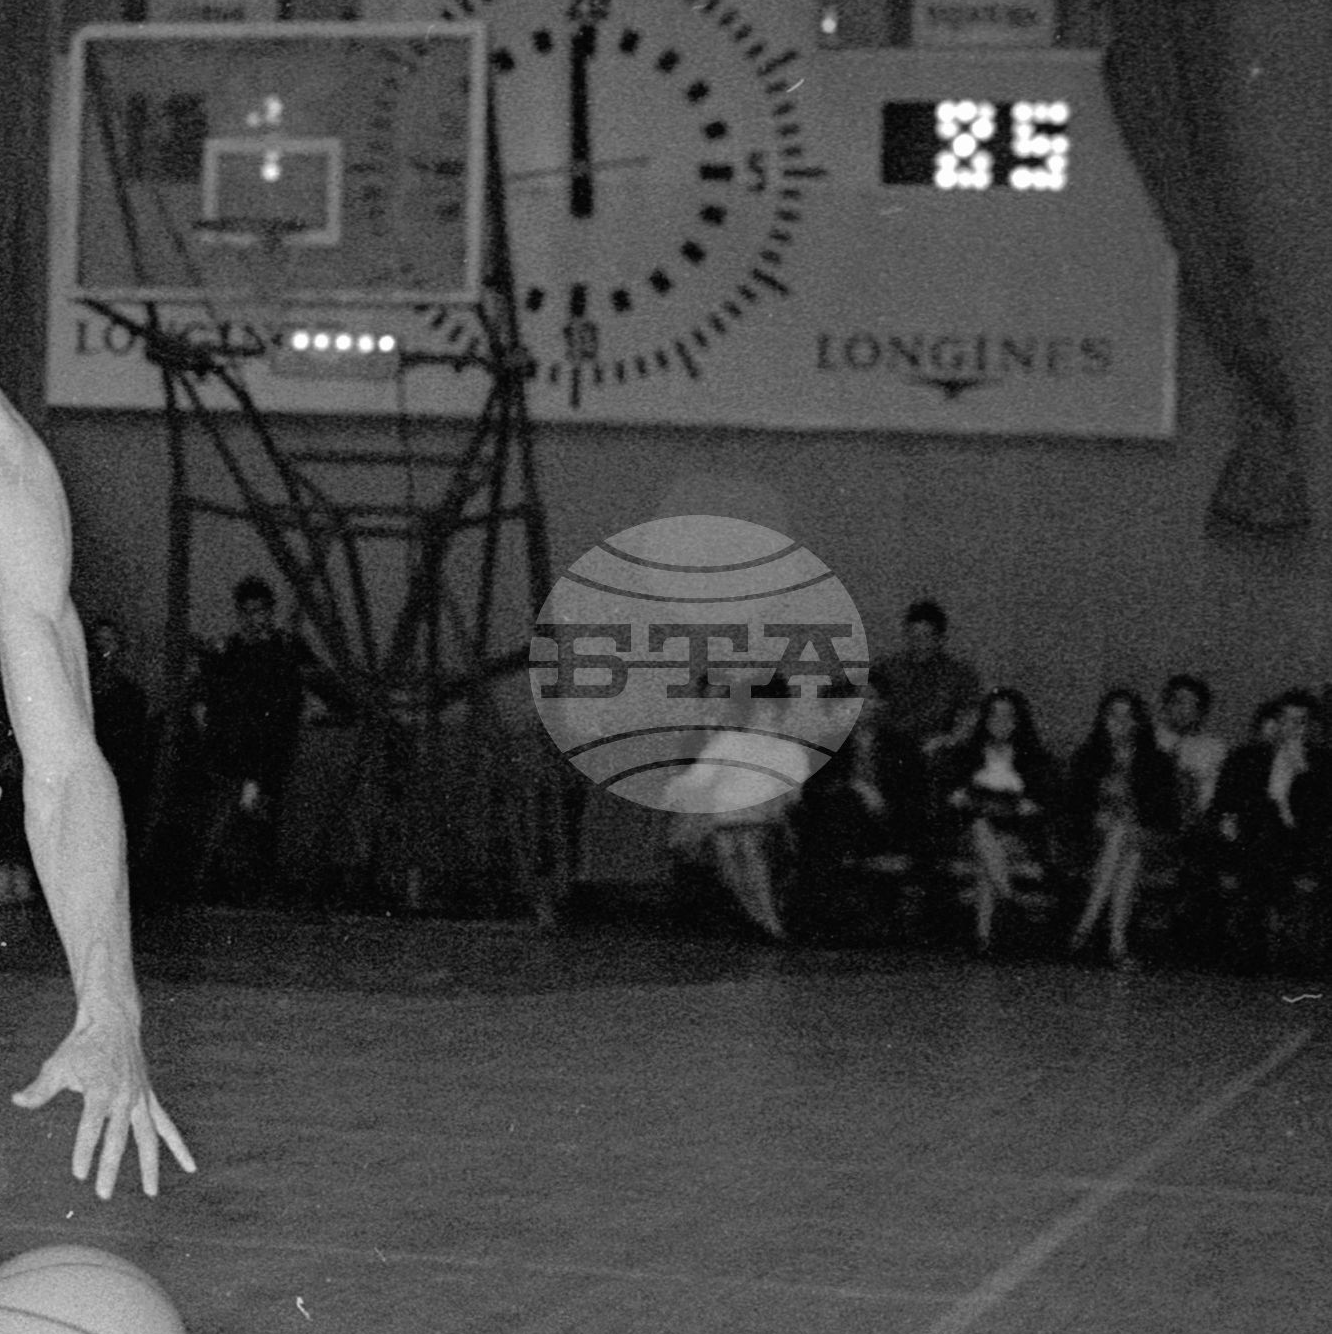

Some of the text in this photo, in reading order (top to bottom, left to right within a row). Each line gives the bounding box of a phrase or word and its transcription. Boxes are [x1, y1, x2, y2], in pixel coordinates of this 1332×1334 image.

[934, 100, 1070, 190] 85
[745, 150, 769, 194] 5
[816, 333, 1114, 376] LONGINES
